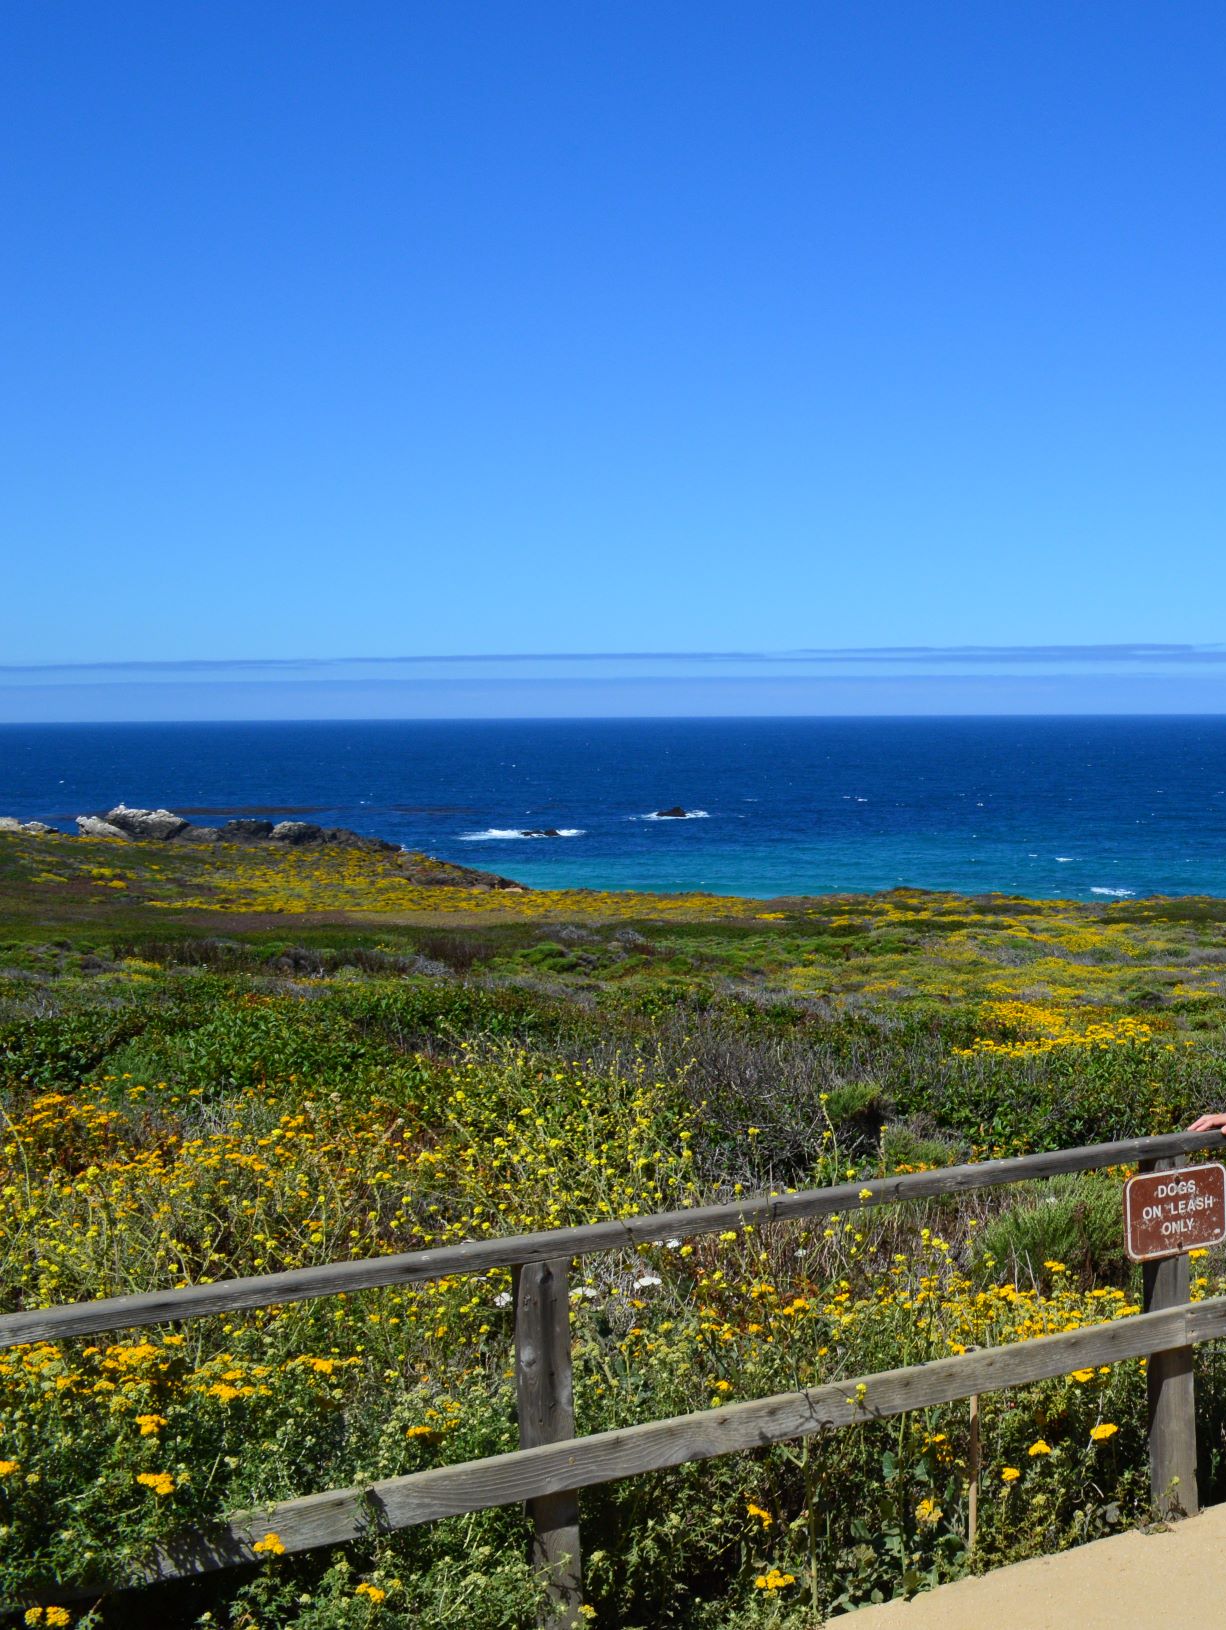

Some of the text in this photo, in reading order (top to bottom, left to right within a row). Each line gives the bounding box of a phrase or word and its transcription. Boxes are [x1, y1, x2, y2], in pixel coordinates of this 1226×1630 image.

[1158, 1180, 1196, 1198] DOGS
[1142, 1195, 1213, 1220] ON LEASH
[1161, 1218, 1194, 1235] ONLY
